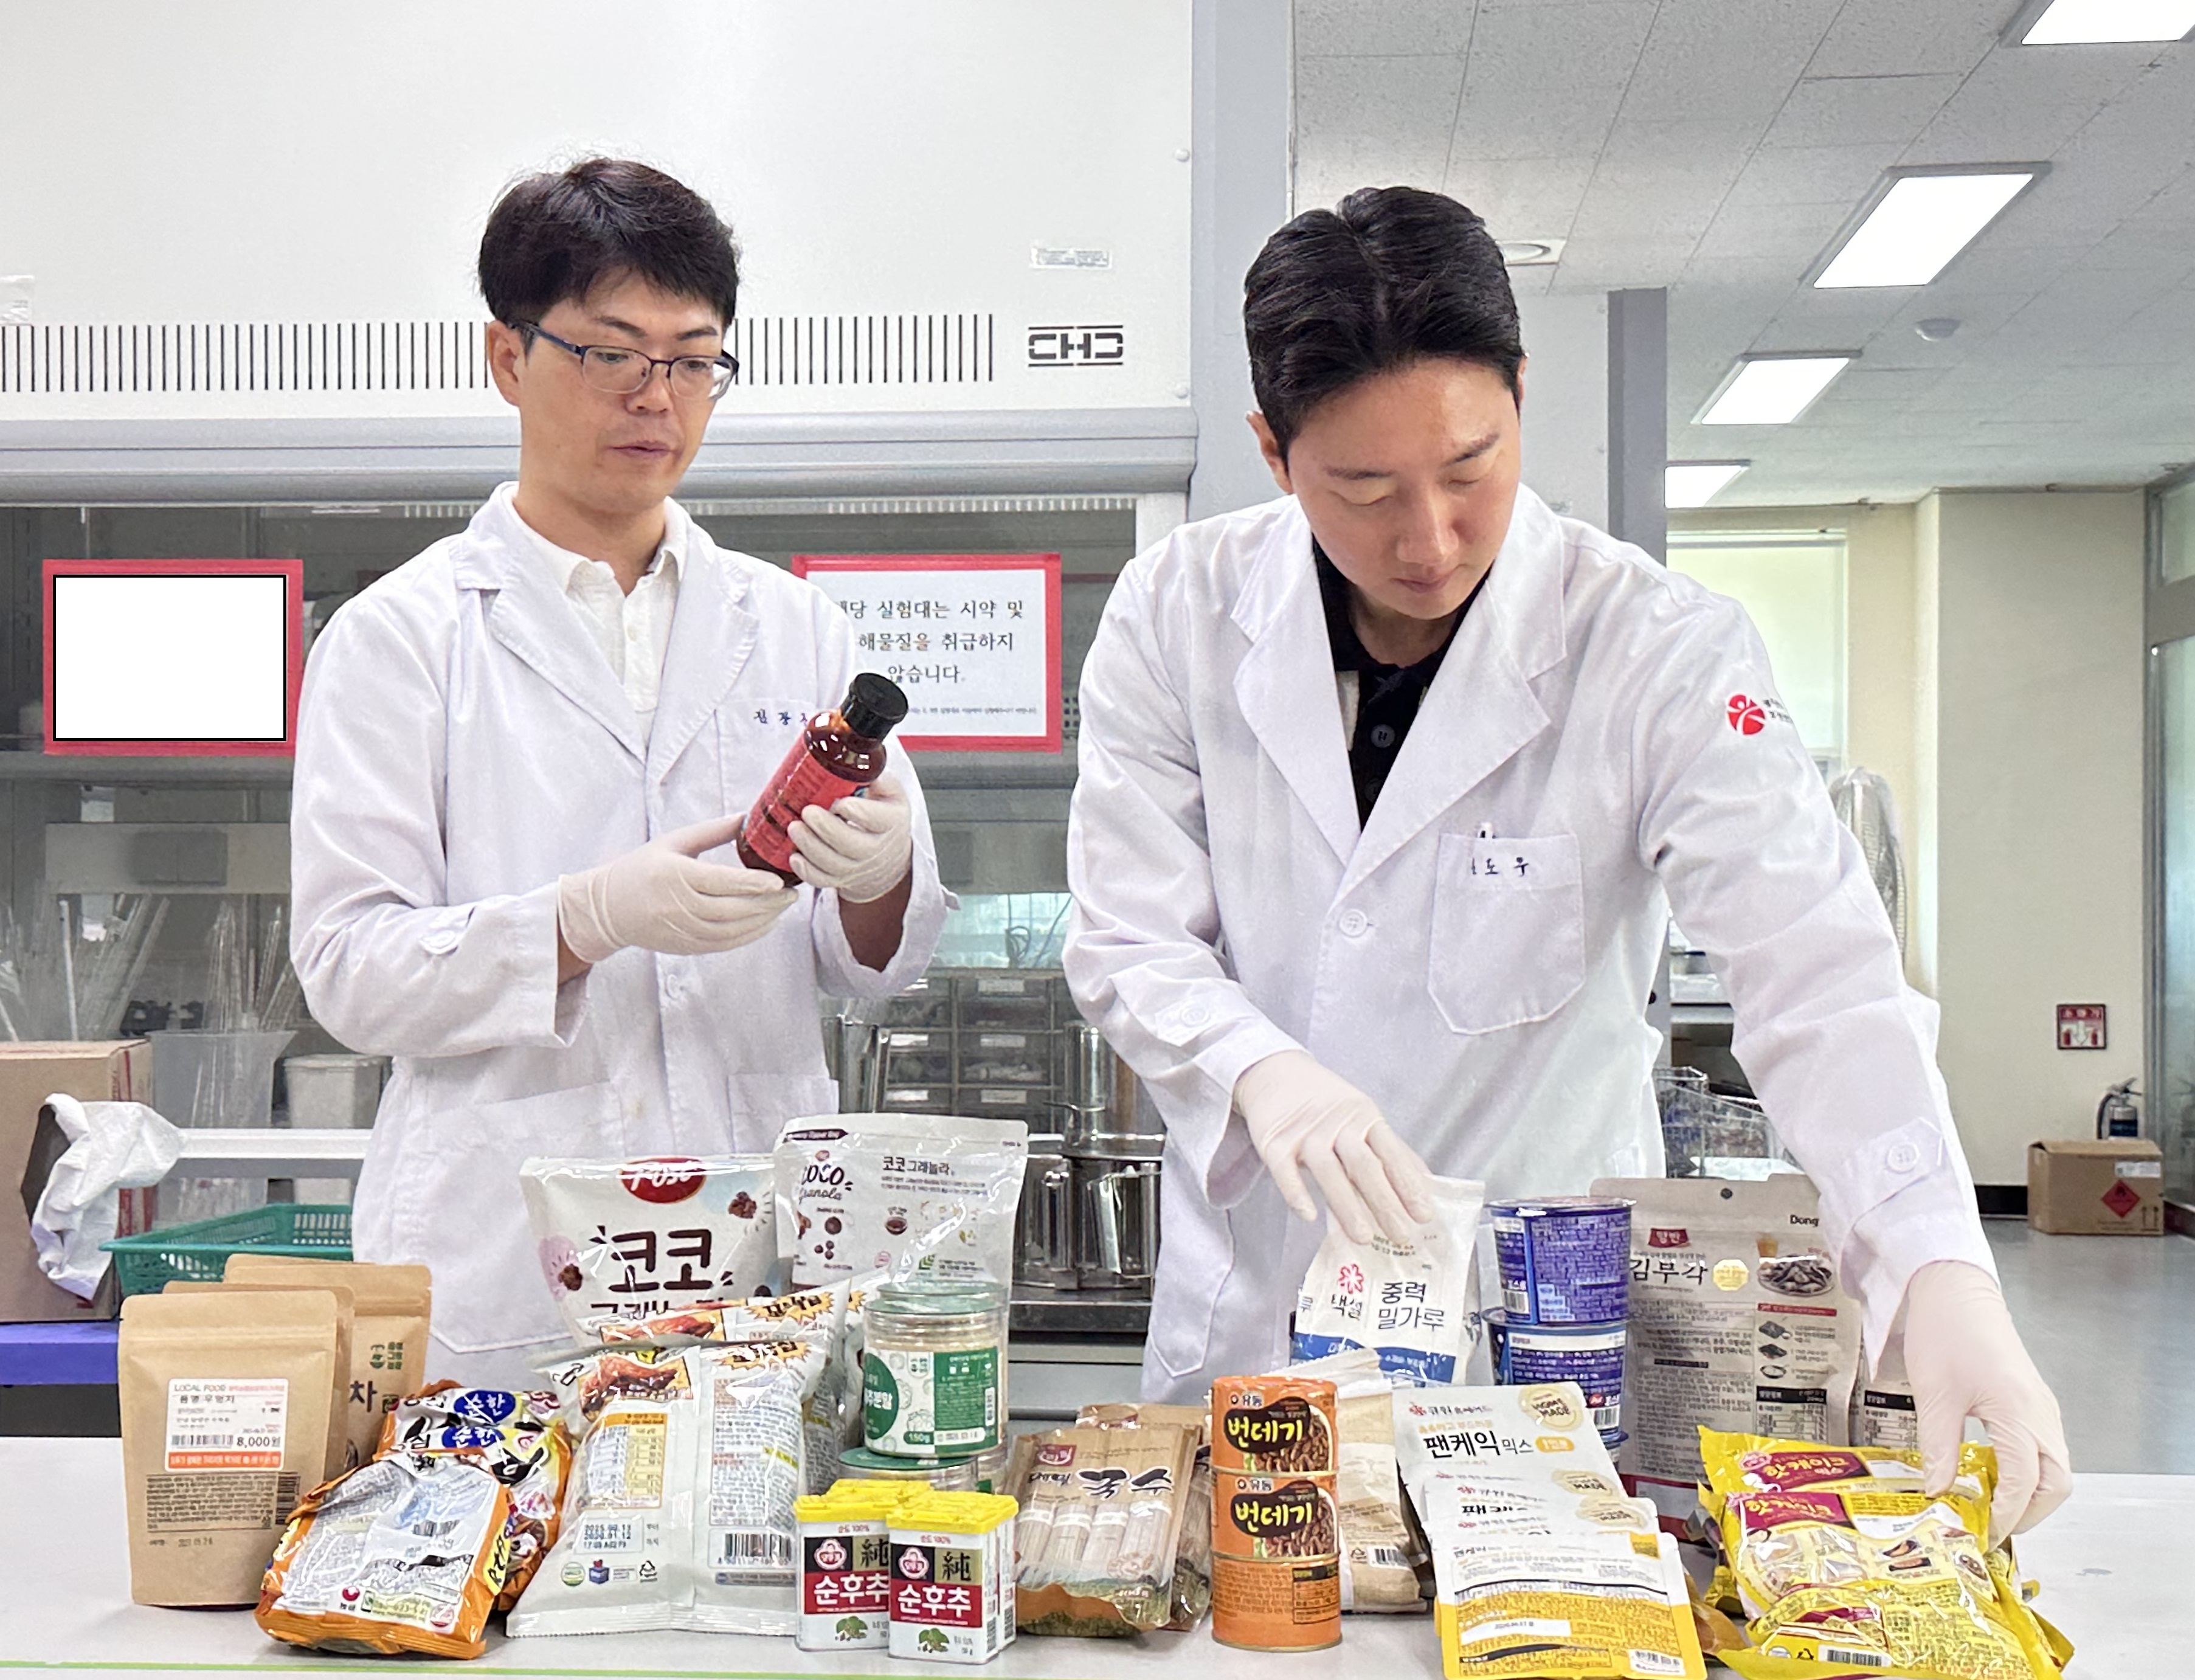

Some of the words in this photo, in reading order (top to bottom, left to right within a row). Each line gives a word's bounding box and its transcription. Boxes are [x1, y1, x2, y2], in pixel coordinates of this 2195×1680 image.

[877, 600, 950, 619] 실험대는
[961, 600, 995, 619] 시약
[1008, 600, 1023, 619] 및
[859, 632, 930, 651] 해물질을
[942, 632, 1013, 651] 취급하지
[608, 1229, 713, 1293] 코코
[1630, 1258, 1709, 1286] 김부각
[1381, 1282, 1426, 1304] 중력
[1378, 1307, 1445, 1332] 밀가루
[1227, 1416, 1304, 1448] 번데기
[1423, 1429, 1501, 1459] 팬케익
[1502, 1437, 1534, 1455] 믹스
[1234, 1500, 1313, 1533] 번데기
[860, 1538, 889, 1568] 純
[942, 1551, 972, 1581] 純
[814, 1572, 890, 1605] 순후추
[897, 1583, 972, 1618] 순후추
